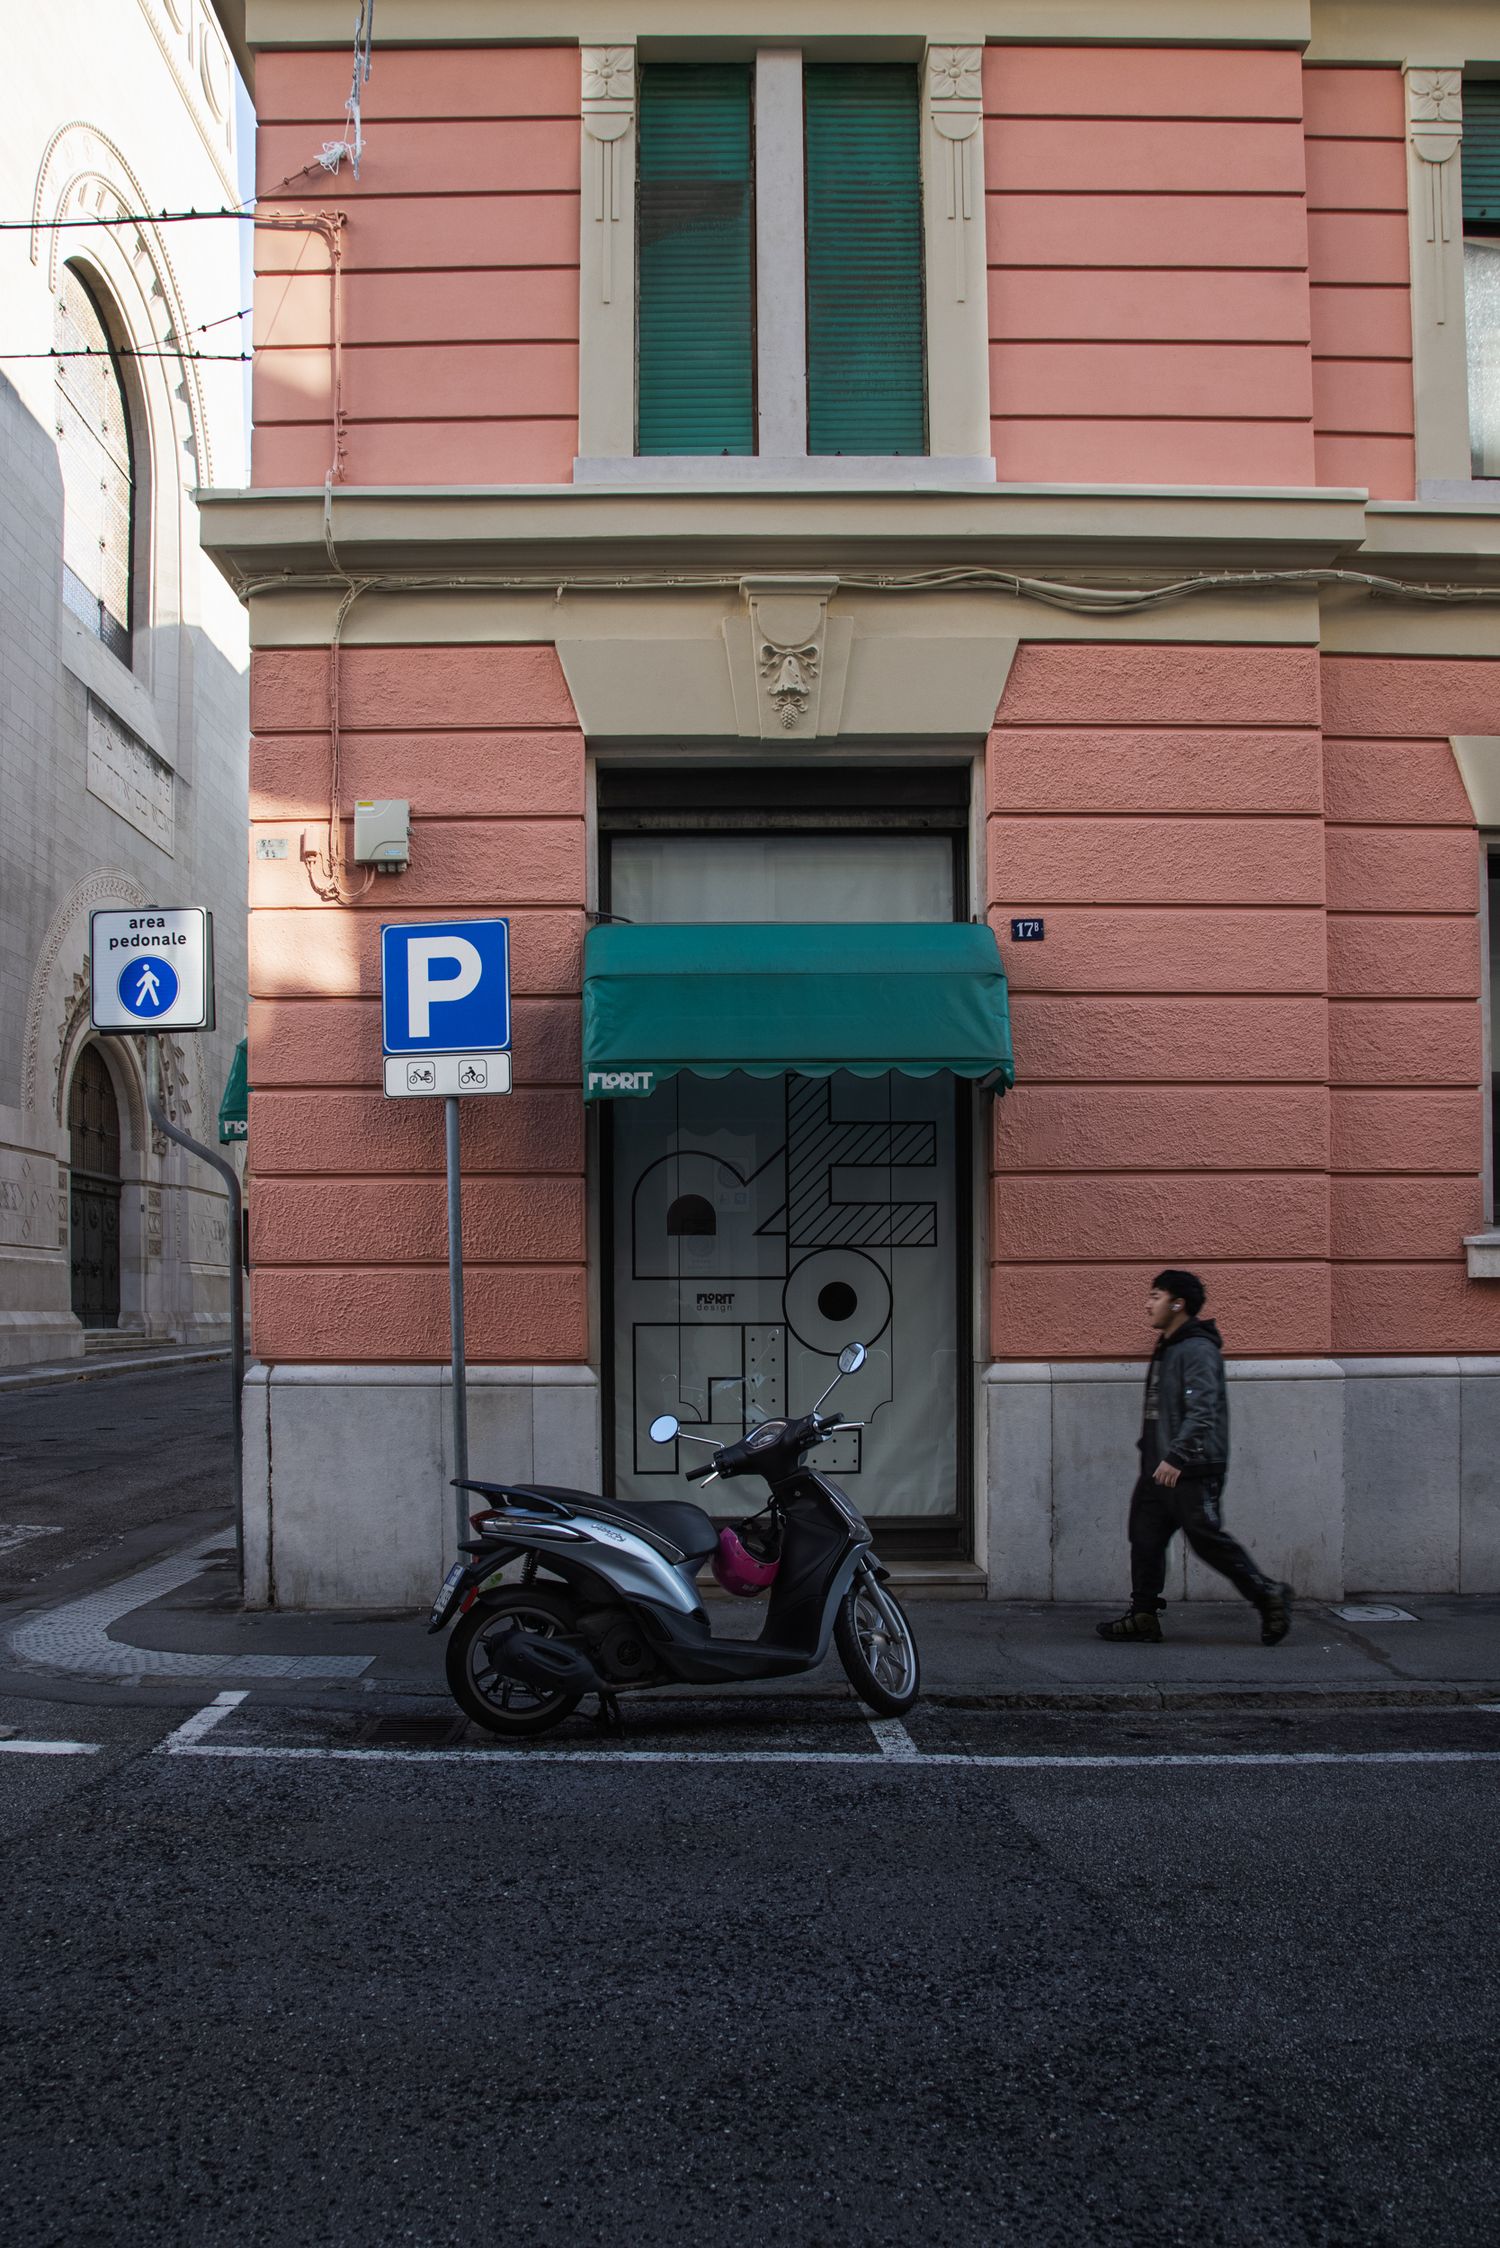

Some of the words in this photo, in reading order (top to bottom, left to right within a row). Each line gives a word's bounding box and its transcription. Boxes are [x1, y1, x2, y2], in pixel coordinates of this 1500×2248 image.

[129, 917, 166, 929] area
[1016, 922, 1040, 937] 17B
[109, 932, 187, 950] pedonale
[407, 936, 483, 1038] P
[588, 1071, 654, 1090] FLORIT
[696, 1293, 736, 1304] FLORIT
[696, 1303, 733, 1313] design
